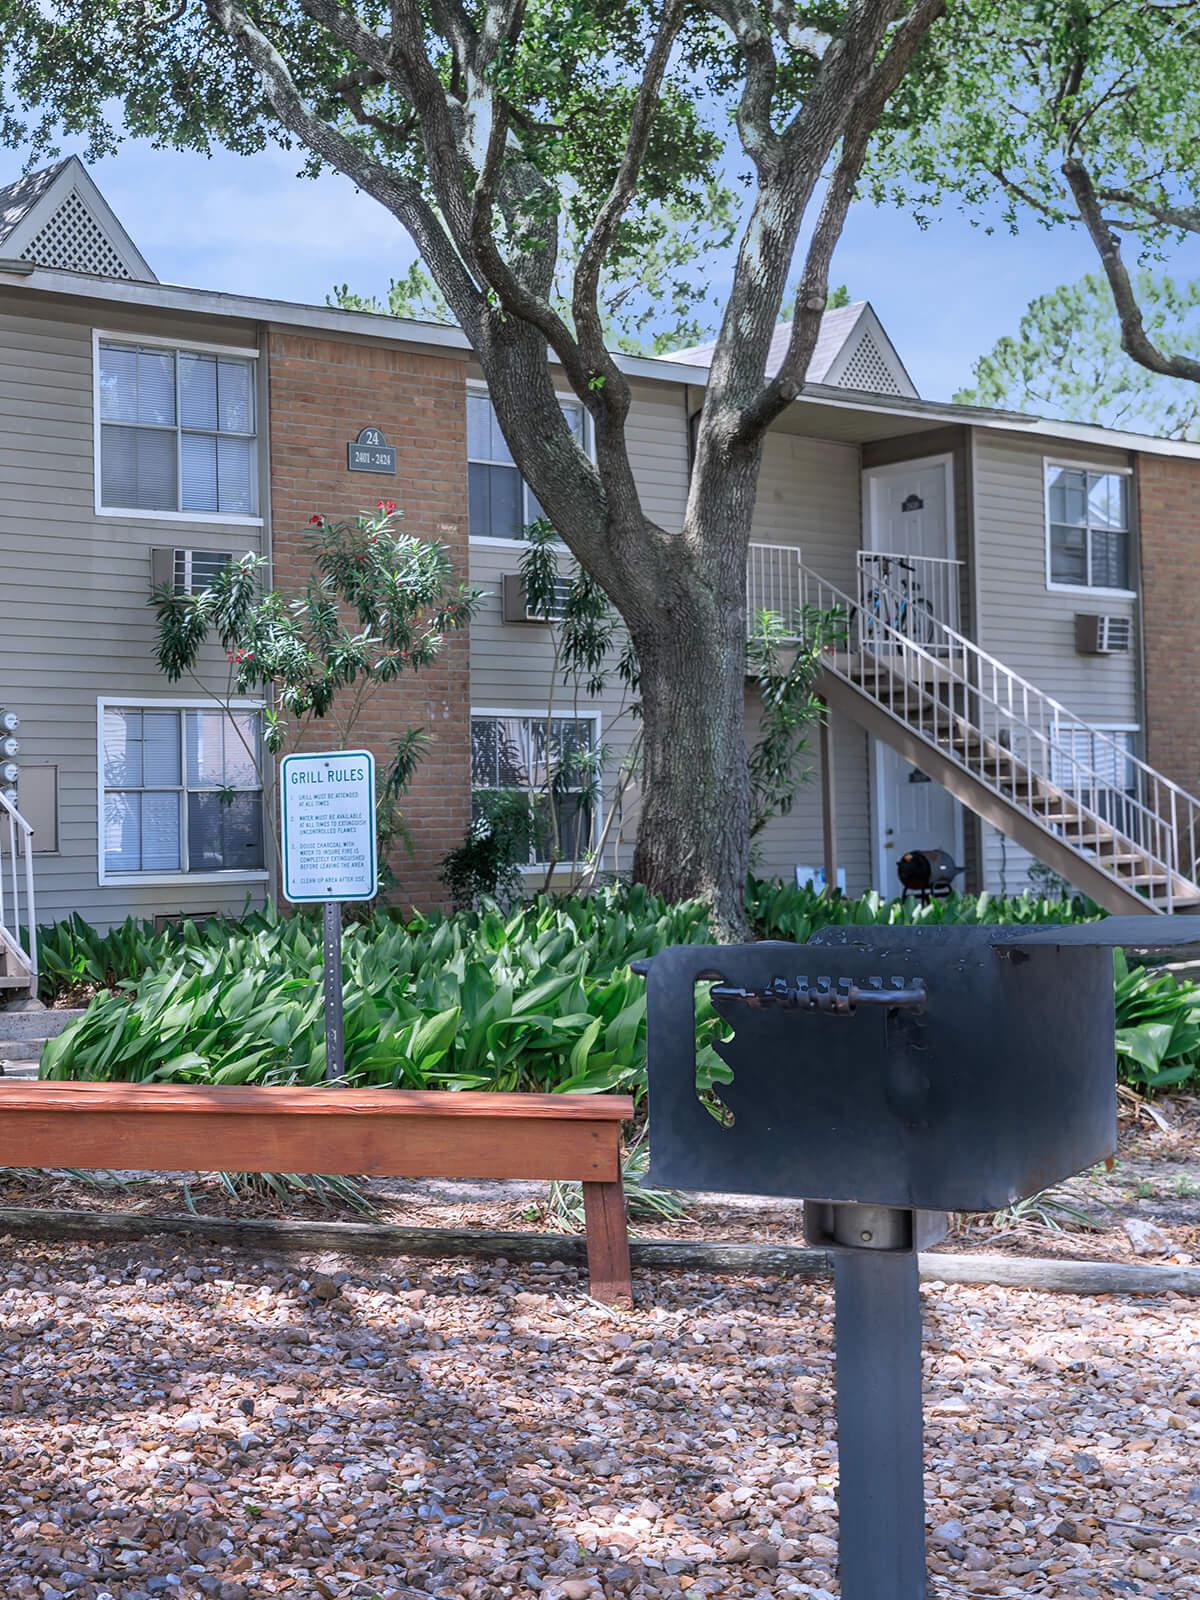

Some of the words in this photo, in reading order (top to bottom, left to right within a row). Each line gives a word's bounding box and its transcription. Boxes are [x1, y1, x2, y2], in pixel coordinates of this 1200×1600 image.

[366, 431, 379, 445] 24
[355, 451, 370, 464] 2401
[291, 771, 324, 784] GRILL
[328, 768, 364, 782] RULES
